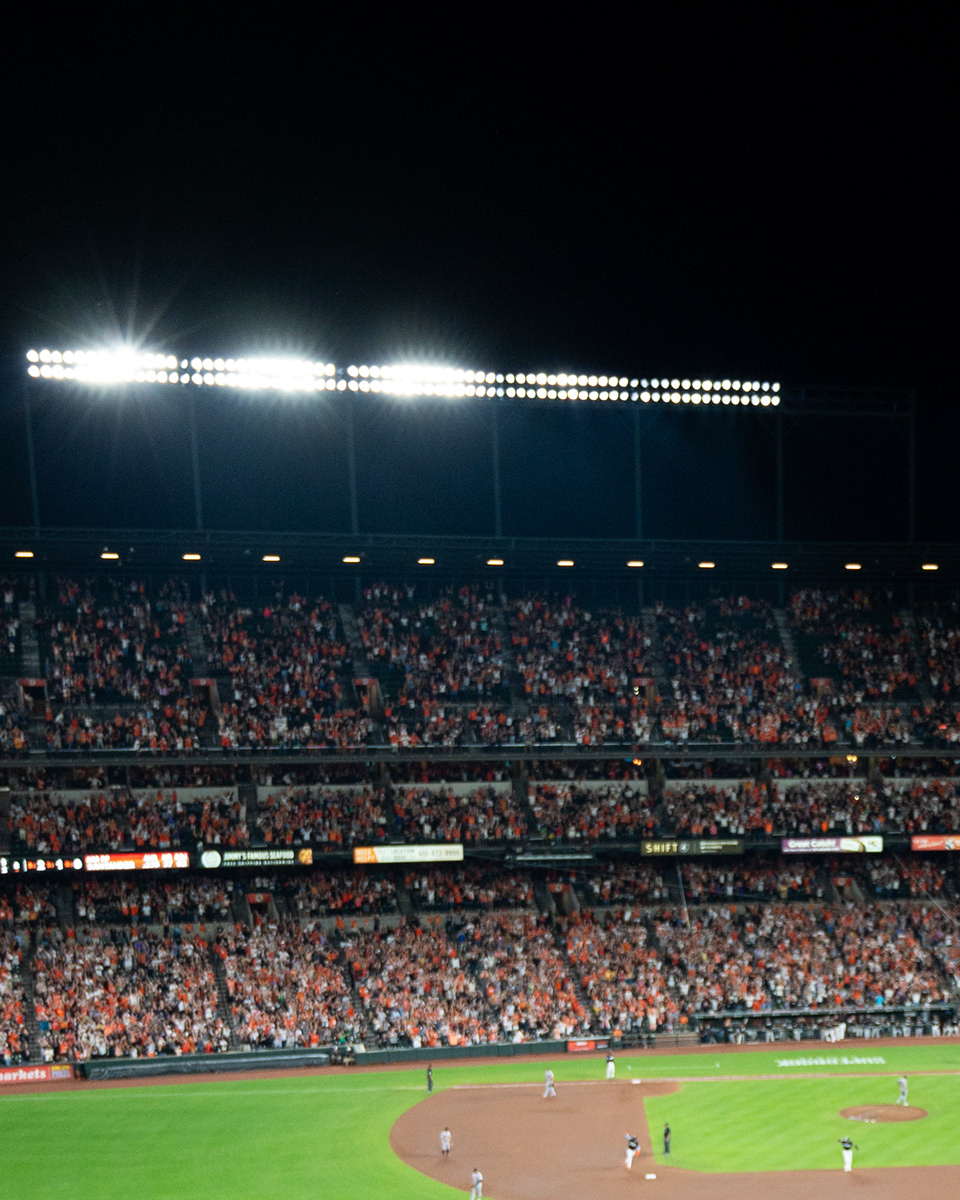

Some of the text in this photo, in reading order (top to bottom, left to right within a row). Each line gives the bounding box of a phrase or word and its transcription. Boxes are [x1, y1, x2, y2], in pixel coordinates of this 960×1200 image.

[644, 842, 678, 853] SHIFT
[788, 839, 810, 848] Great
[247, 851, 269, 860] FAMOUS
[270, 850, 294, 860] SEAFOOD
[0, 1069, 46, 1081] arkets
